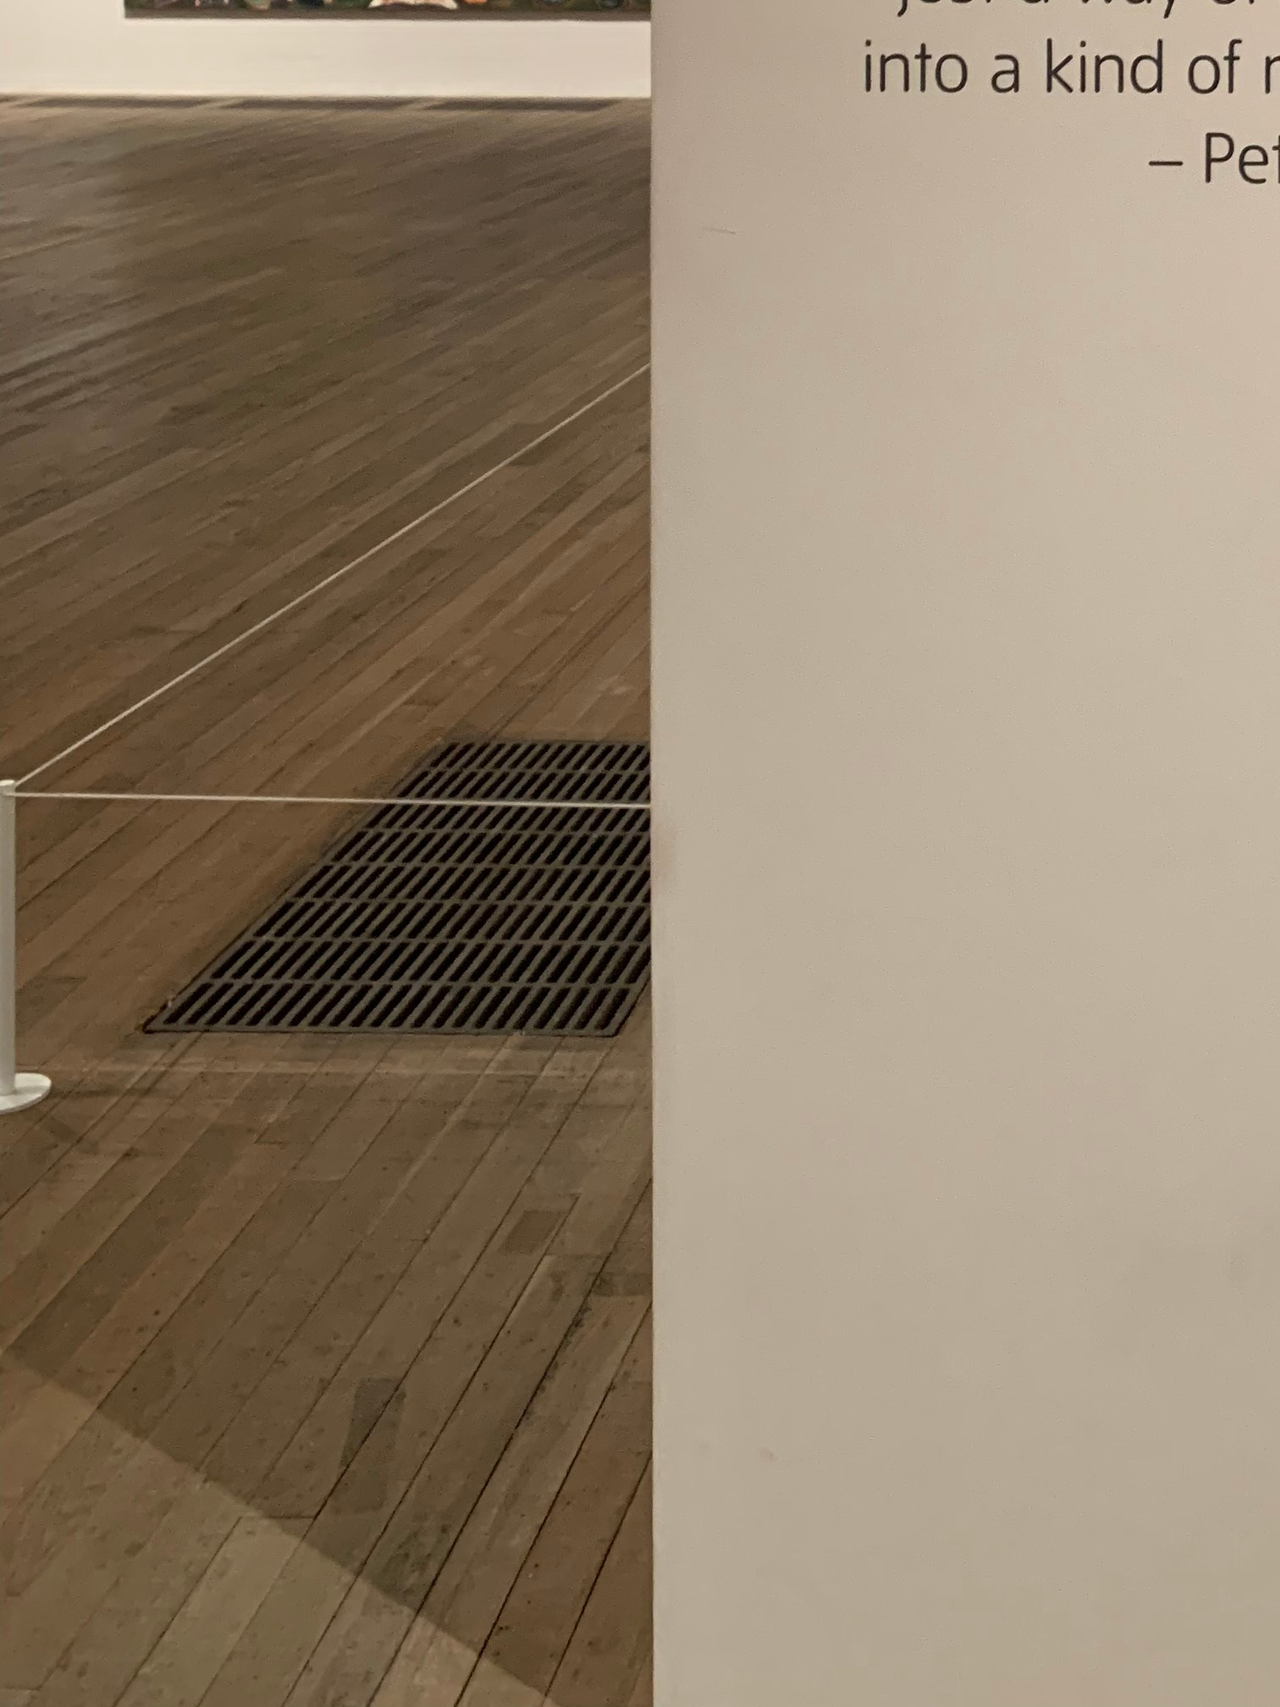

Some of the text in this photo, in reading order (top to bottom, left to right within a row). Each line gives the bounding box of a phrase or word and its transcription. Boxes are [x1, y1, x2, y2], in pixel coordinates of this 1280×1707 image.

[864, 38, 969, 94] into
[990, 53, 1020, 94] a
[1045, 37, 1164, 95] kind
[1187, 38, 1243, 95] of
